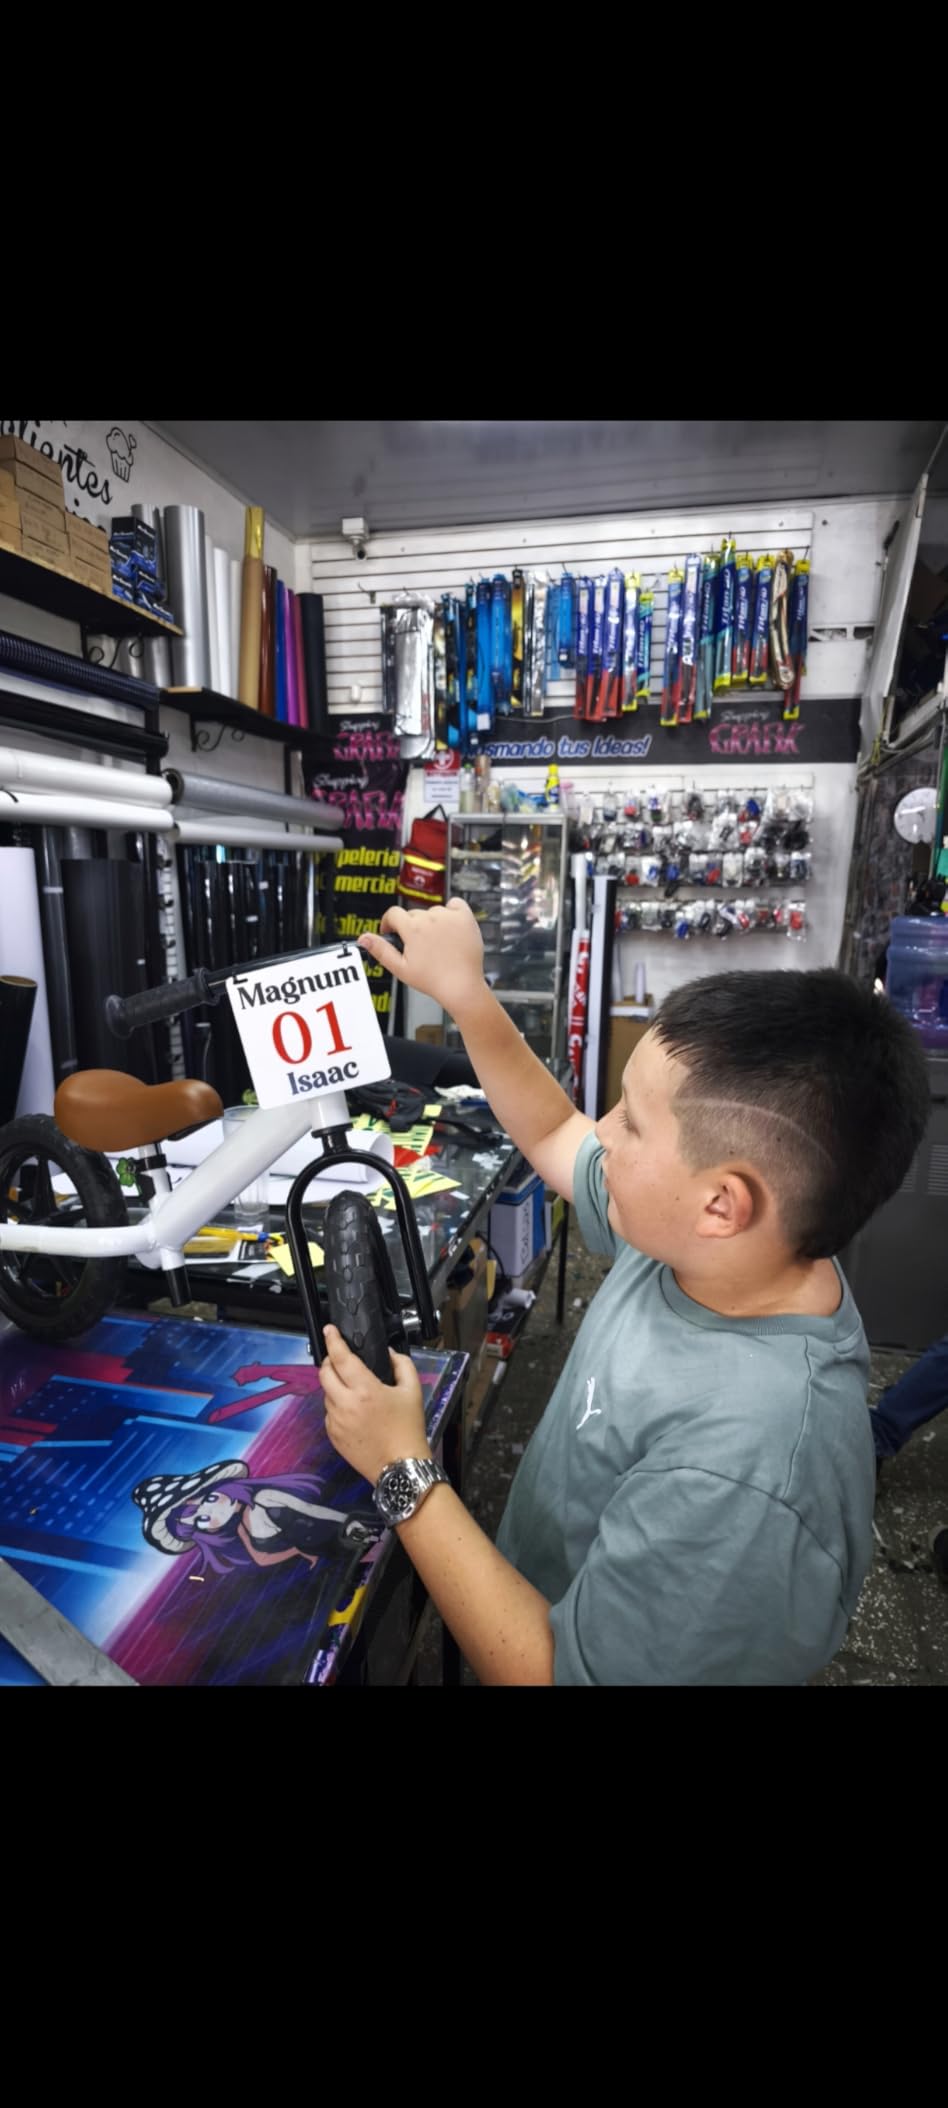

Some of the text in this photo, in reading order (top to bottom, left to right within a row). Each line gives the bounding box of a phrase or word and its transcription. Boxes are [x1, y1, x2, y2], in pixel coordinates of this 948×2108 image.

[476, 733, 653, 759] smando tus Ideas!
[238, 964, 360, 1011] Magnum
[272, 1001, 353, 1065] 01
[286, 1060, 360, 1096] Isaac
